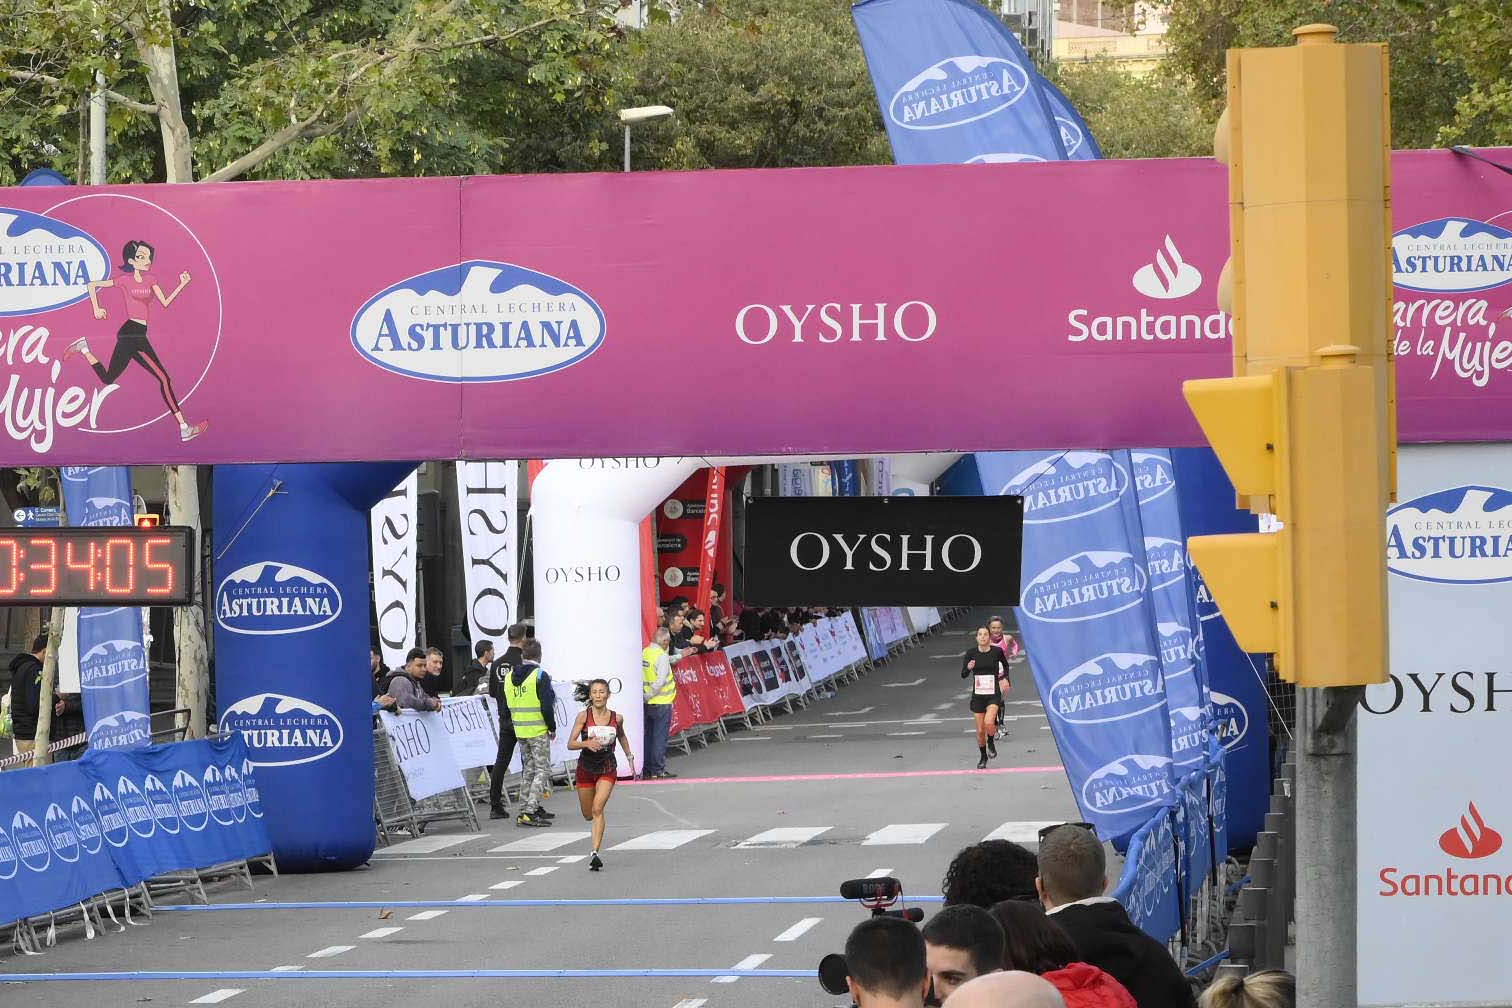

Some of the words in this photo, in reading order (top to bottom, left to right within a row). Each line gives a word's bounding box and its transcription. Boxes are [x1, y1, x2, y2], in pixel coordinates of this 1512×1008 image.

[13, 244, 86, 255] LECHERA
[1407, 243, 1458, 252] CENTRAL
[410, 303, 489, 317] CENTRAL
[496, 301, 578, 314] LECHERA
[1393, 298, 1489, 327] arrera
[370, 308, 586, 352] ASTURIANA
[735, 301, 938, 345] OYSHO
[1068, 308, 1234, 342] Santand
[1416, 328, 1435, 356] la
[1414, 520, 1481, 530] CENTRAL
[789, 531, 983, 573] OYSHO
[545, 564, 621, 585] OYSHO
[277, 586, 328, 594] LECHERA
[220, 589, 333, 619] ASTURIANA
[225, 722, 333, 748] TURIANA
[280, 718, 328, 726] LECHERA
